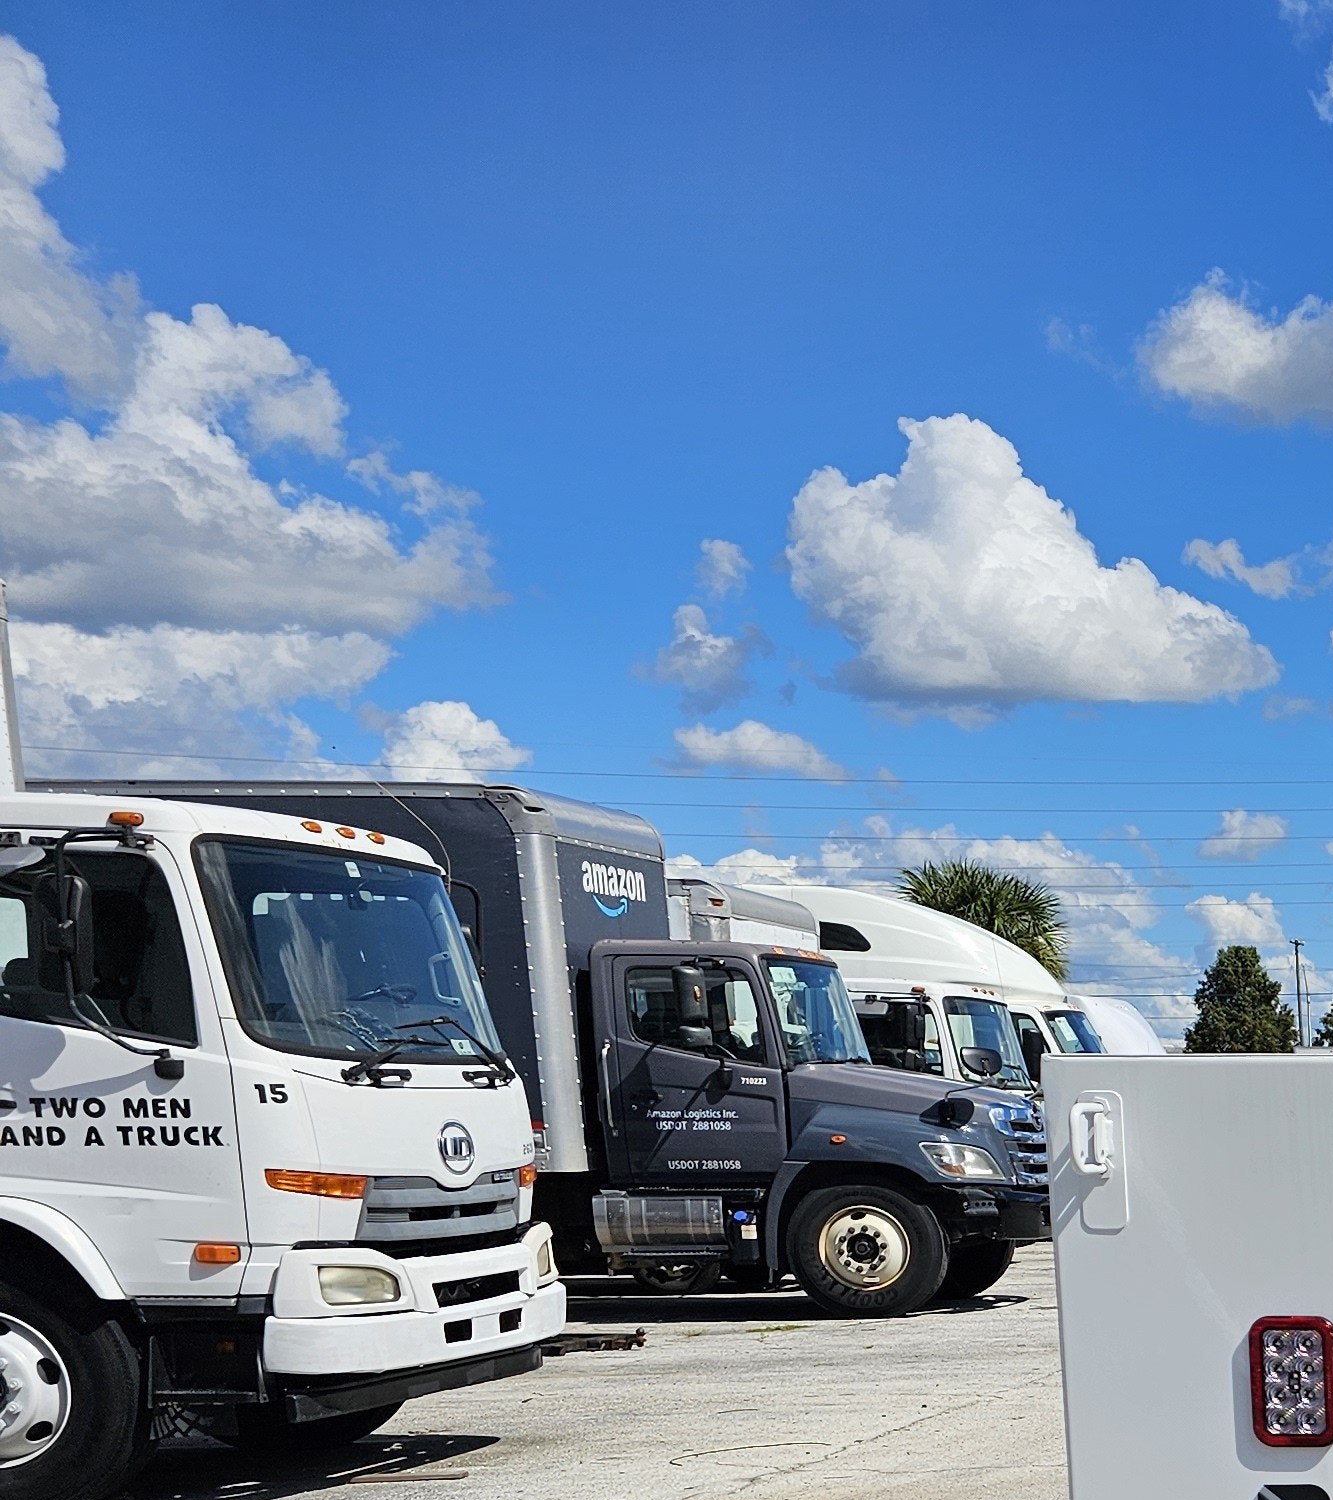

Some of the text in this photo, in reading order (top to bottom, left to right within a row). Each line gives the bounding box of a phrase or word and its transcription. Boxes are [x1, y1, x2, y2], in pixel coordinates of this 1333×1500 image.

[581, 860, 646, 902] amazon
[253, 1083, 289, 1104] 15
[29, 1097, 191, 1119] TWO MEN
[646, 1108, 739, 1121] Amazon Logistics Inc.
[0, 1125, 225, 1147] AND A TRUCK
[656, 1121, 732, 1131] USDOT 2881058
[667, 1160, 741, 1170] USDOT 2881058
